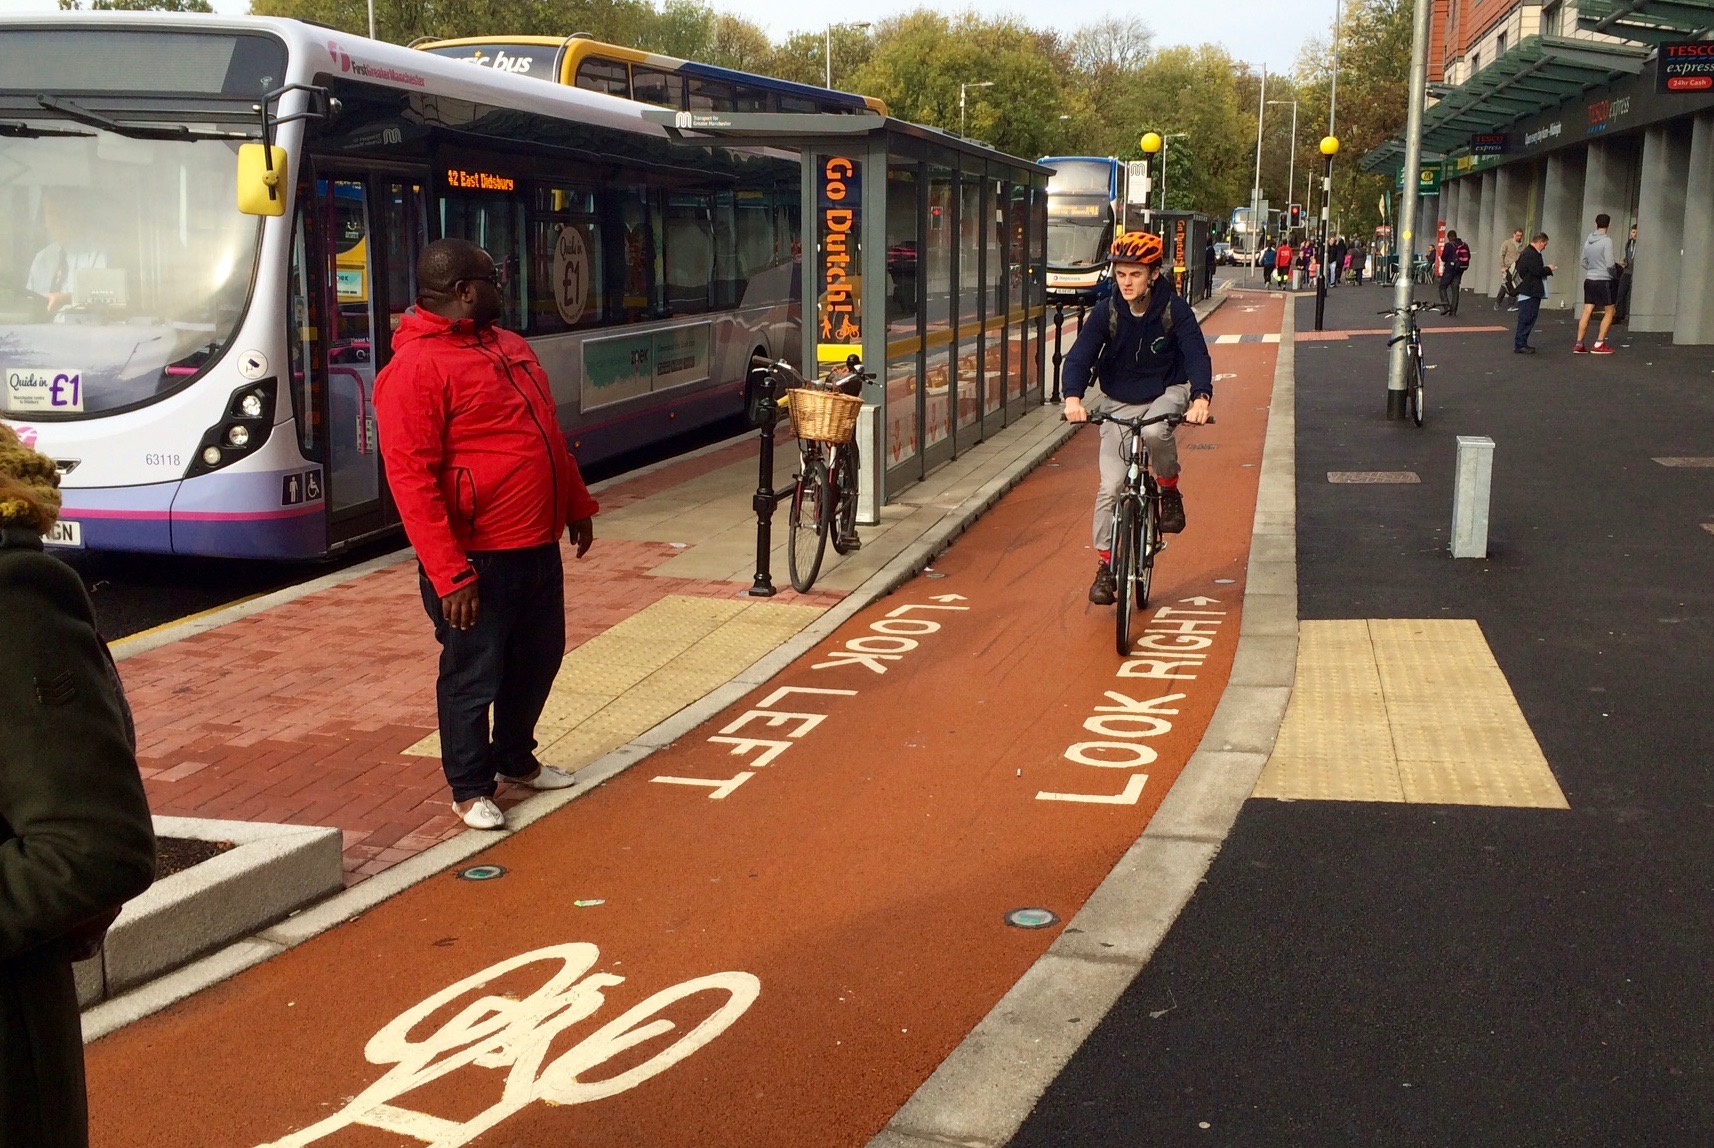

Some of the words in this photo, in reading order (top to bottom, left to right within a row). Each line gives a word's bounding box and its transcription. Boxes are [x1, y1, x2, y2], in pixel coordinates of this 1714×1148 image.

[492, 51, 533, 73] bus
[1666, 45, 1714, 57] TESCO
[1666, 63, 1714, 76] express
[1587, 99, 1610, 125] TESCO
[1475, 144, 1502, 152] express
[460, 171, 479, 188] East
[480, 173, 514, 191] Didsbury
[826, 157, 852, 200] Go
[826, 209, 852, 312] Dutch!
[562, 260, 580, 307] £1
[10, 373, 38, 391] Quids
[39, 377, 48, 387] in
[49, 373, 79, 406] £1
[146, 453, 181, 466] 63118
[811, 604, 970, 675] LOOK
[1035, 690, 1187, 805] LOOK
[1116, 606, 1227, 680] RIGHT
[648, 685, 859, 799] LEFT
